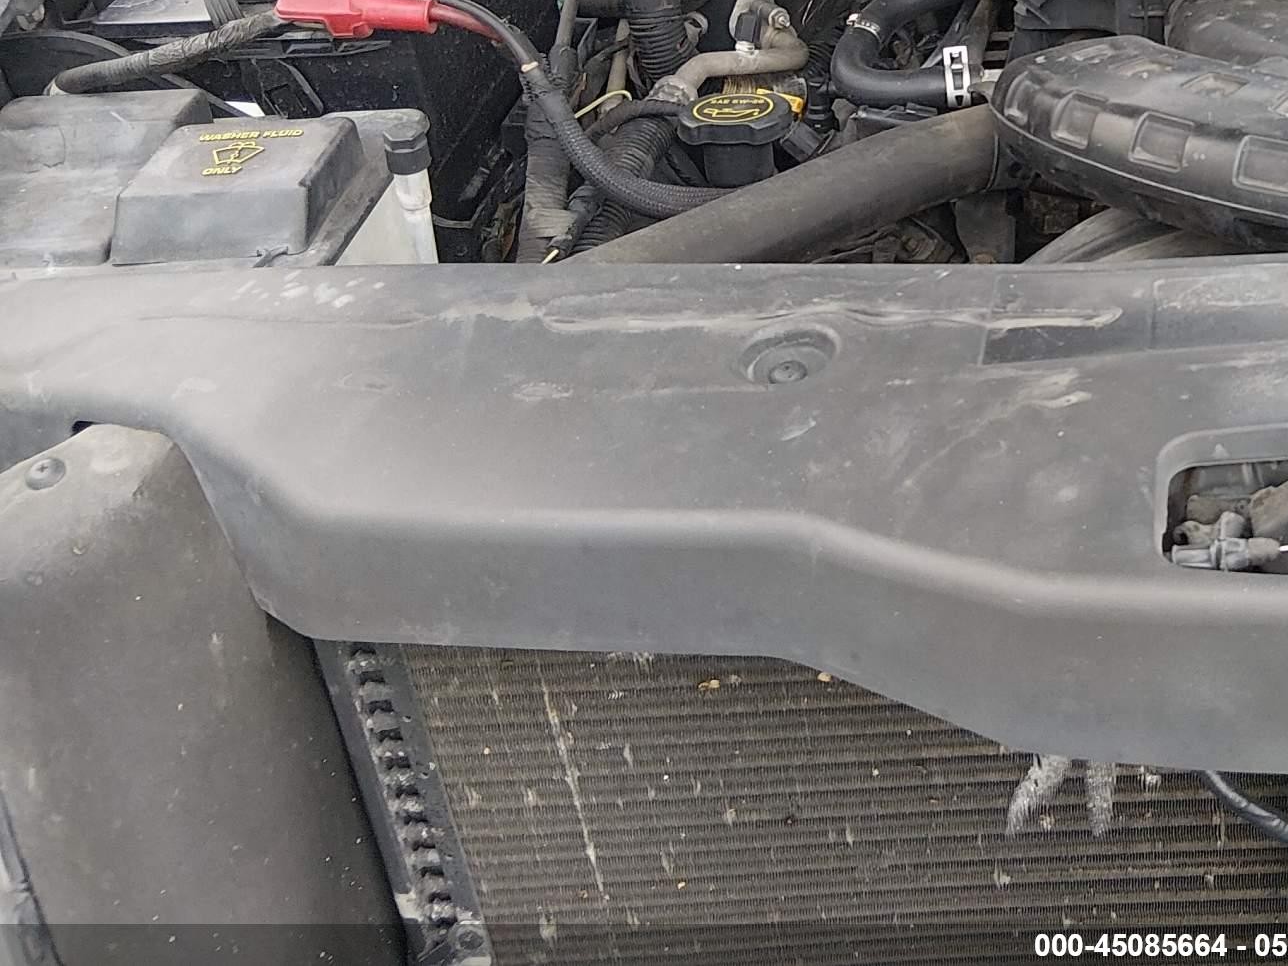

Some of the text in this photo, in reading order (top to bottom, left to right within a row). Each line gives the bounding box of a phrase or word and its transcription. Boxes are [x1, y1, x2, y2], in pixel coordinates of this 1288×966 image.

[199, 129, 304, 141] WASHER FLUID
[202, 166, 243, 175] ONLY
